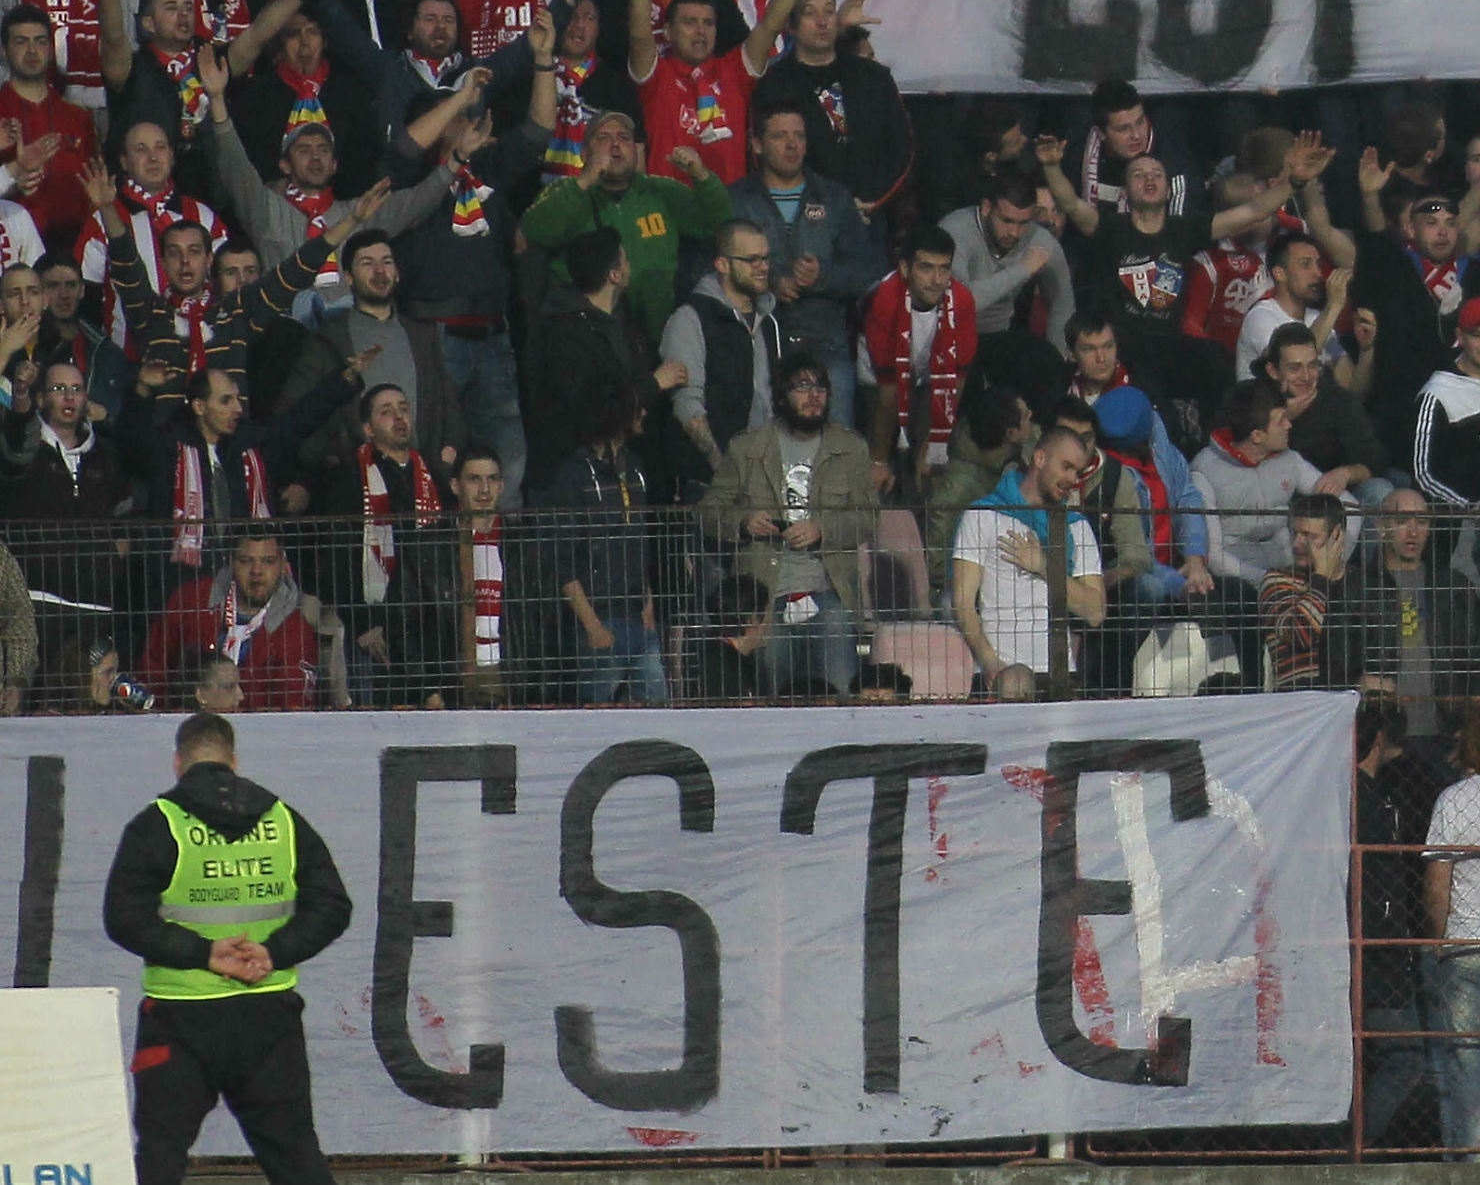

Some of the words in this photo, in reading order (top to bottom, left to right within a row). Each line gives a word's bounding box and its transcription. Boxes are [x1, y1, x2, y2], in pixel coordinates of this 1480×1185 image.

[497, 1, 532, 26] ad
[635, 212, 668, 239] 10
[1135, 272, 1149, 301] UTA
[189, 820, 277, 846] ORNE
[203, 856, 273, 879] ELITE
[189, 887, 240, 903] BODYGUARD
[246, 881, 285, 899] TEAM
[371, 737, 1207, 1112] ESTE
